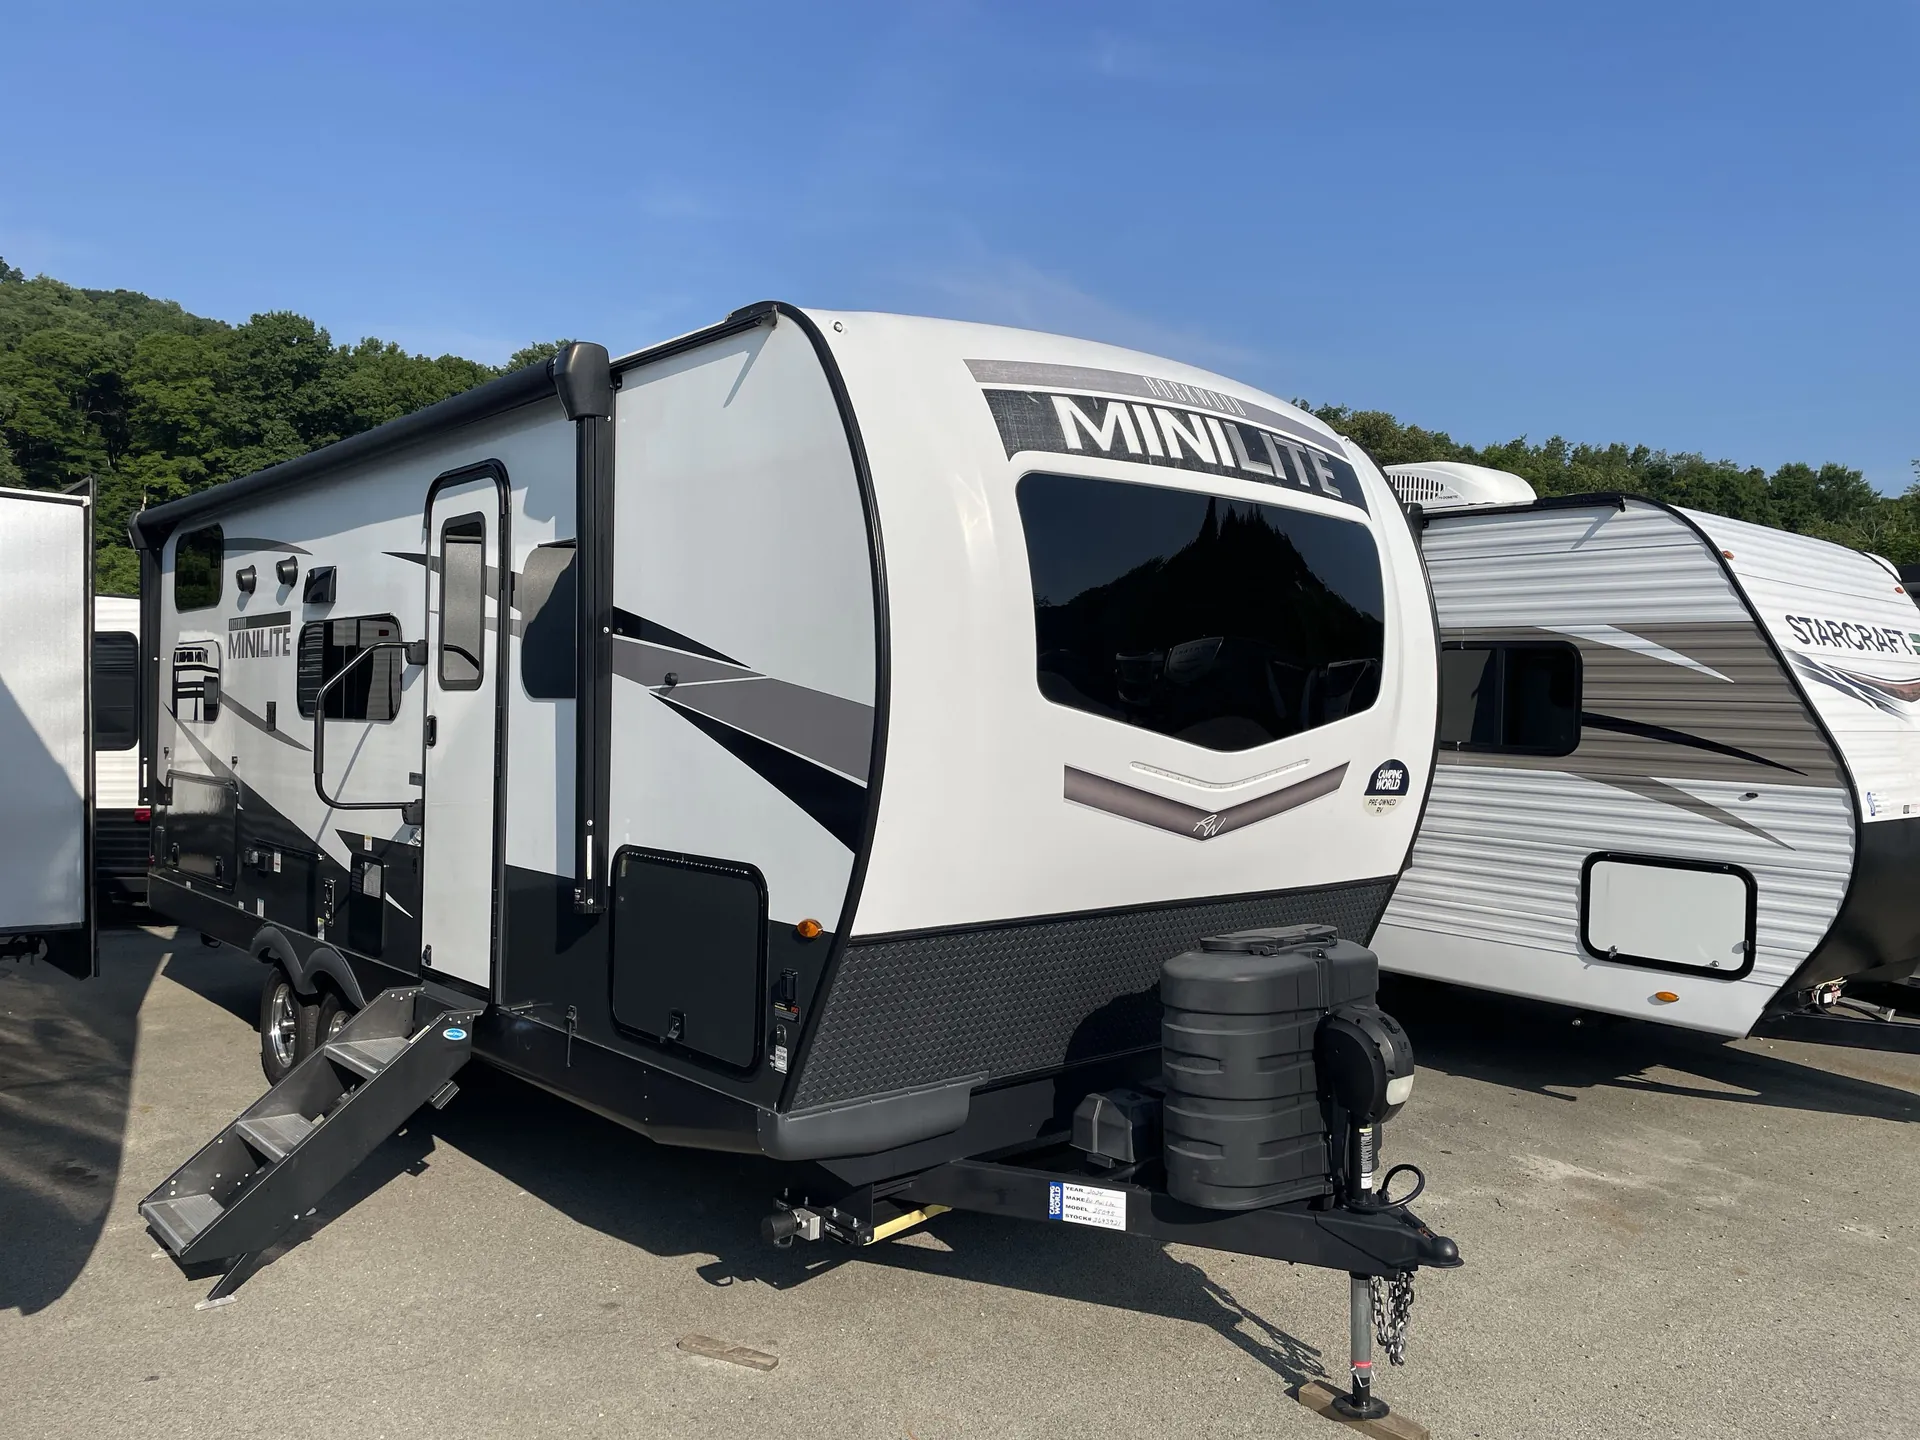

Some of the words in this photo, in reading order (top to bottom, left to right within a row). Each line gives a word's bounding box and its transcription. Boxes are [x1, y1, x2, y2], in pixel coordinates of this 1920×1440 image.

[1142, 376, 1247, 417] ROCKWOOD
[1050, 395, 1343, 499] MINILITE
[228, 626, 291, 660] MINILITE
[1785, 613, 1914, 656] STARCRAFT
[1376, 779, 1400, 790] WORLD
[1378, 770, 1402, 779] CAMPING
[1065, 1204, 1088, 1212] MODEL
